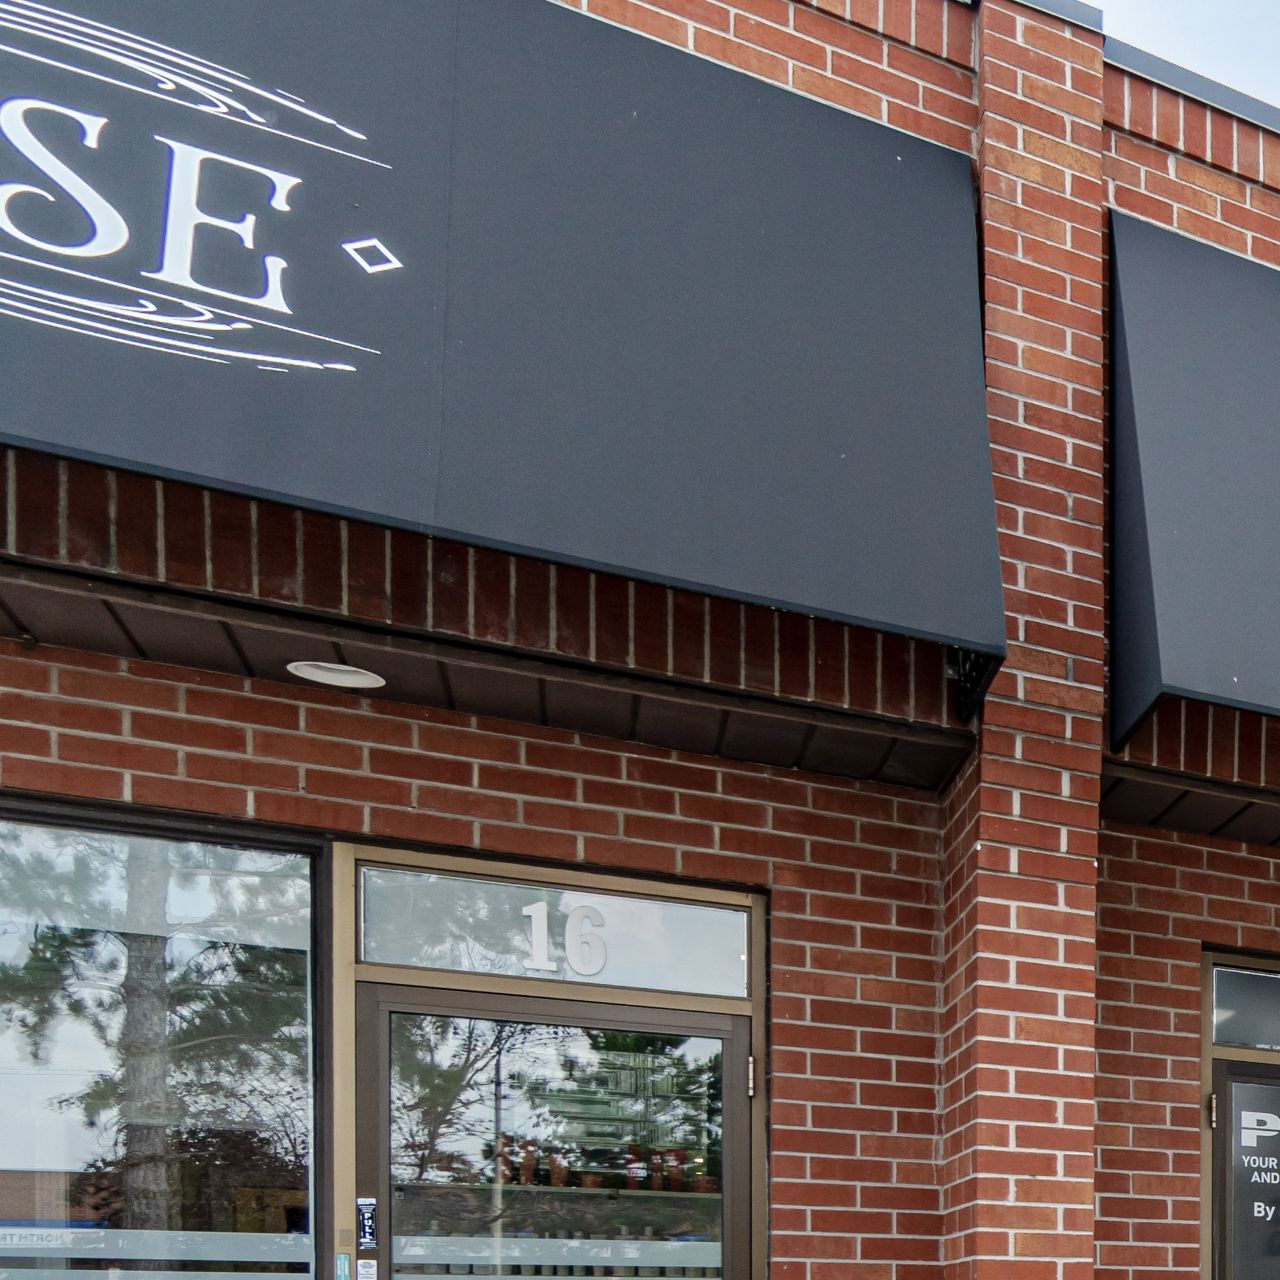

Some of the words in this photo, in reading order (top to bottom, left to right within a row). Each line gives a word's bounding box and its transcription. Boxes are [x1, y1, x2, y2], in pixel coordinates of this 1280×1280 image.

[522, 899, 608, 977] 16
[1241, 1154, 1278, 1170] YOUR
[1251, 1170, 1280, 1184] AND
[1253, 1201, 1276, 1221] By
[364, 1212, 373, 1239] PULL
